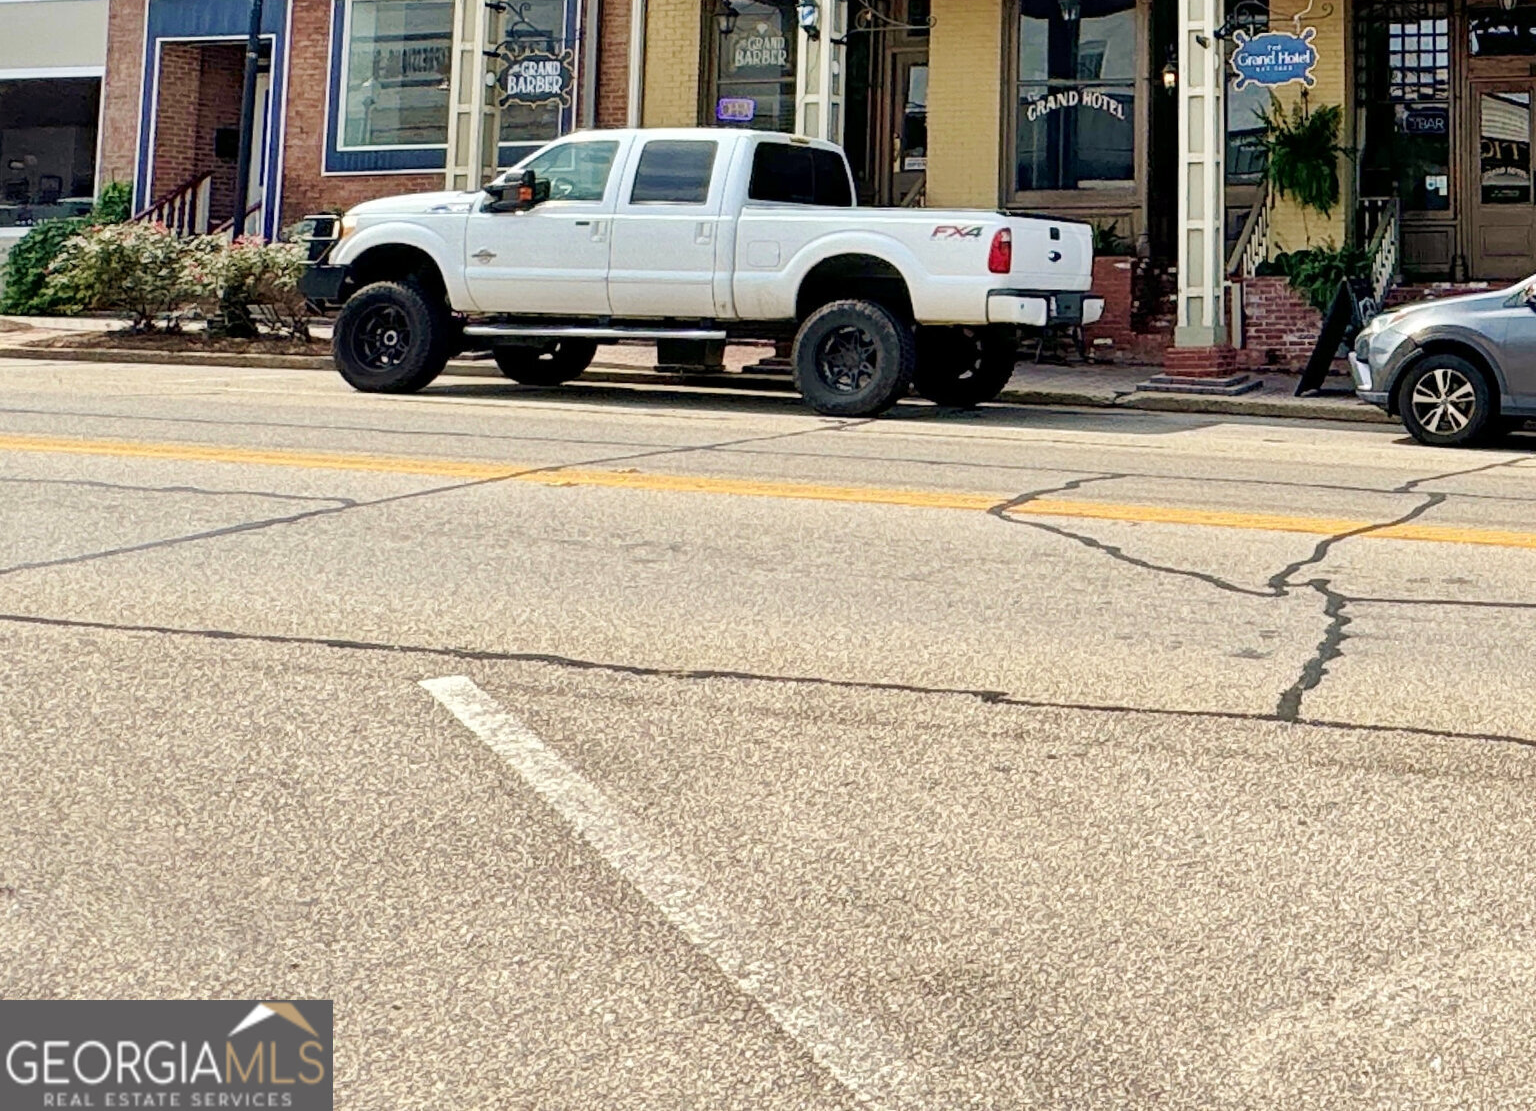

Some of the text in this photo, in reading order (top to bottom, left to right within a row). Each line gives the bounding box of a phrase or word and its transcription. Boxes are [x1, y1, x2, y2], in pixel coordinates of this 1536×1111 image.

[748, 36, 785, 50] GRAND
[735, 50, 787, 66] BARBER
[1238, 50, 1311, 66] Grand Hotel
[521, 61, 560, 76] GRAND
[507, 75, 562, 95] BARBER
[1027, 89, 1125, 121] GRAND HOTEL
[931, 225, 983, 238] FX4
